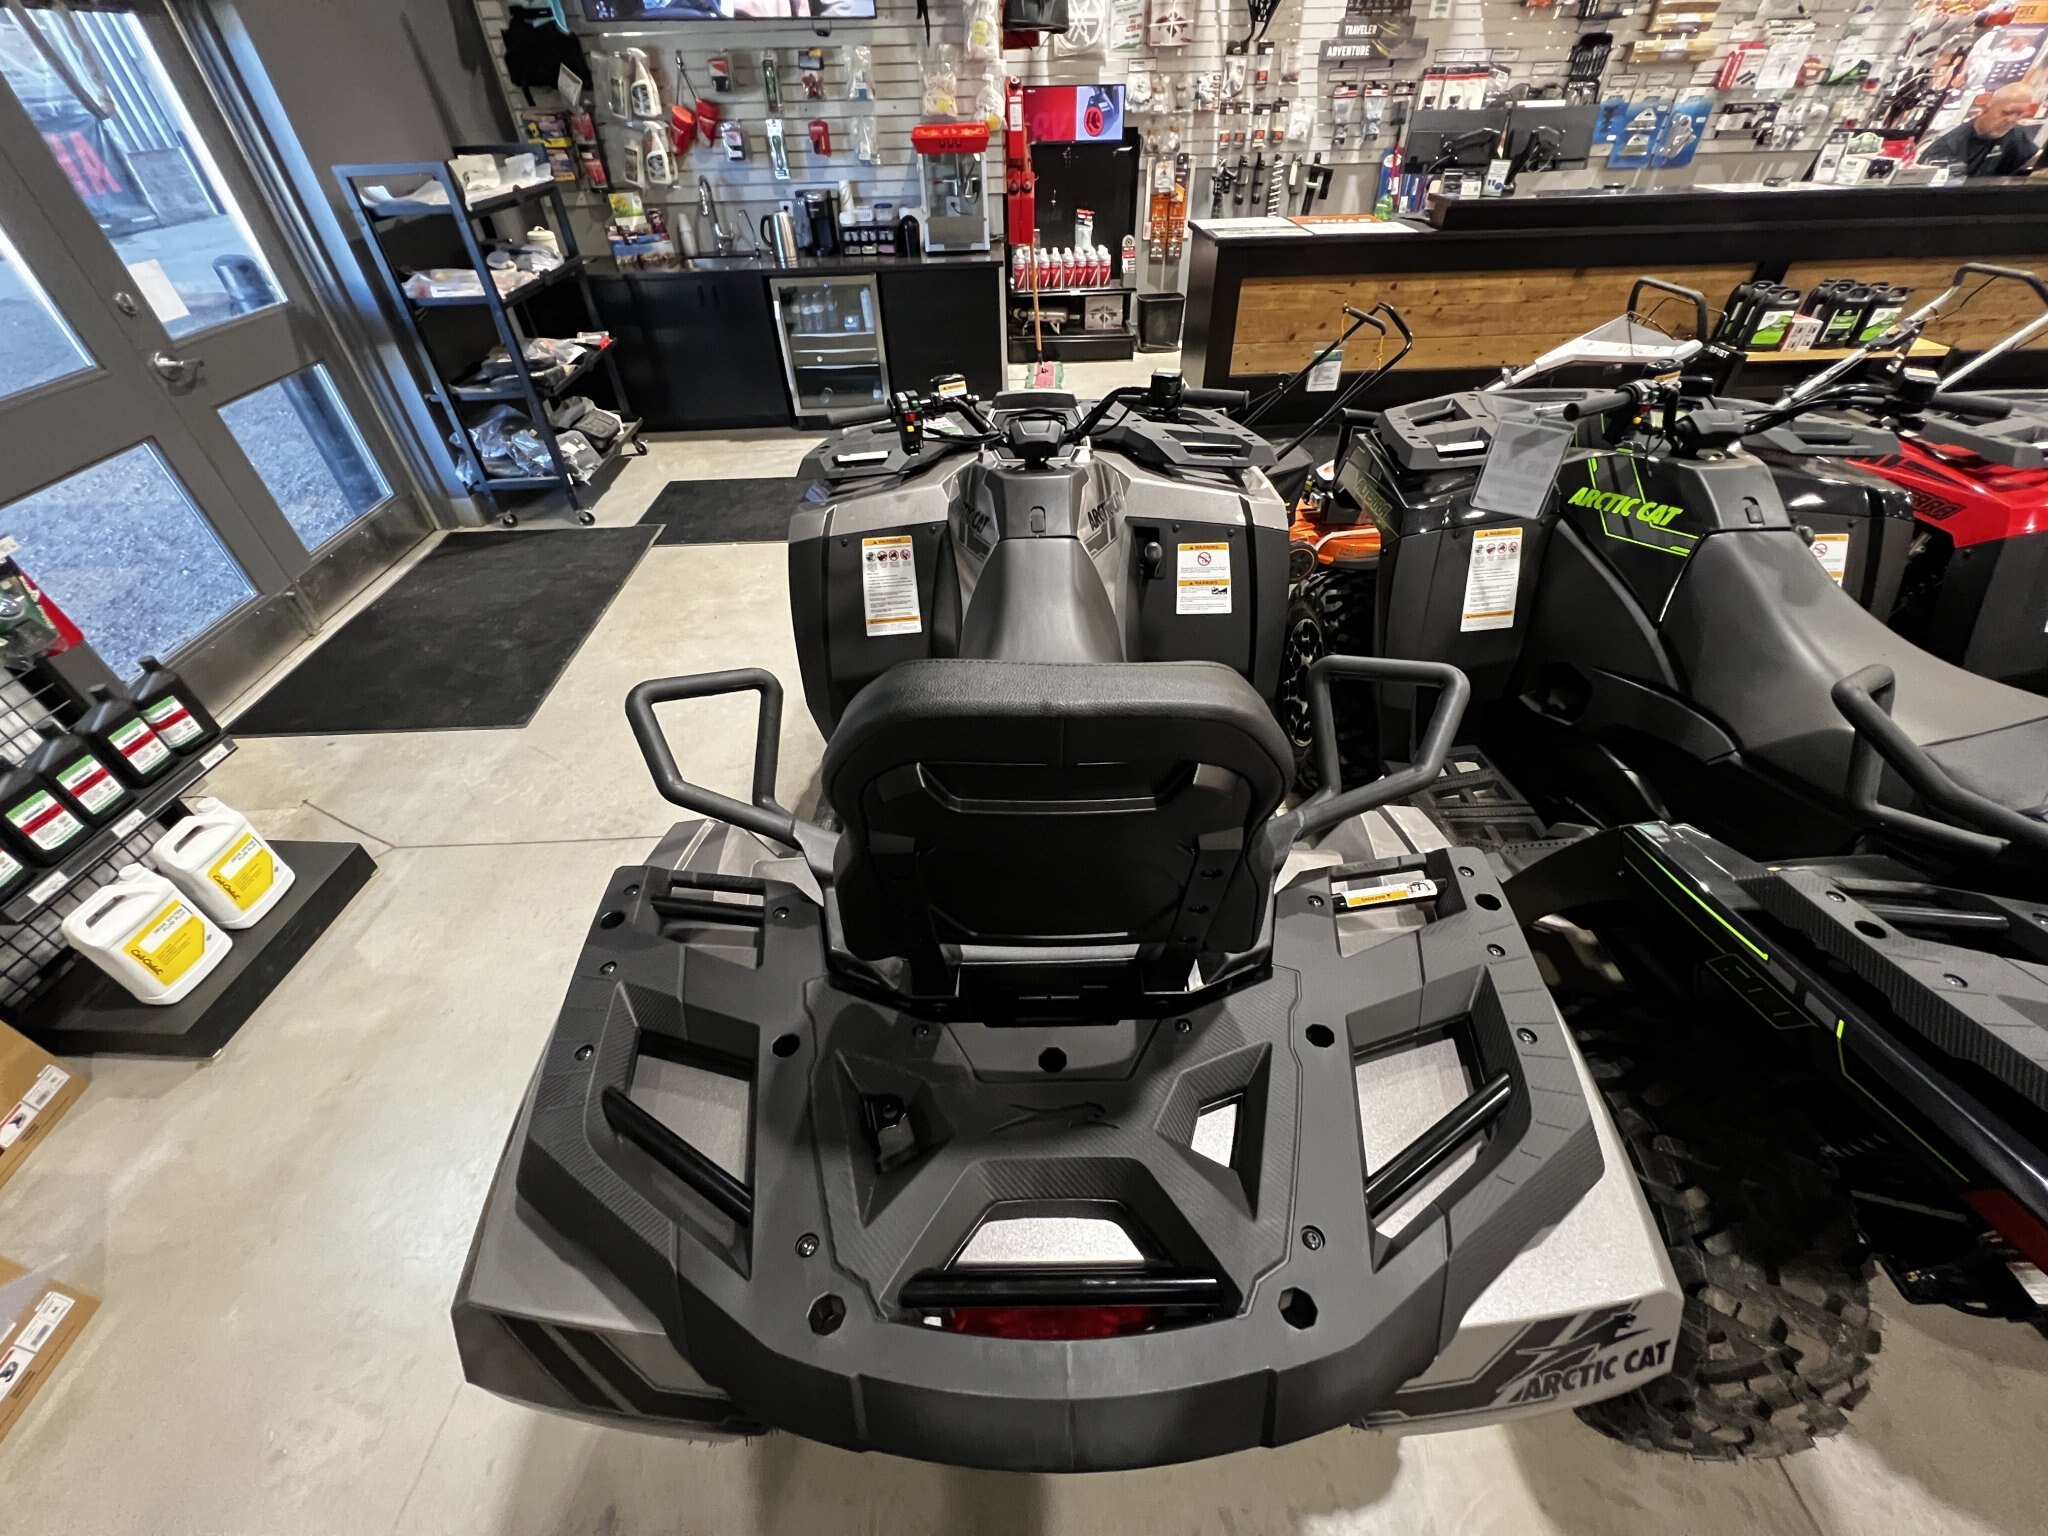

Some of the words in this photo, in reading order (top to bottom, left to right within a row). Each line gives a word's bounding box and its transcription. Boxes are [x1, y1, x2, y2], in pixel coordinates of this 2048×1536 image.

[1344, 24, 1378, 35] TRAVELER
[1326, 45, 1371, 56] ADVENTURE
[1567, 487, 1642, 517] ARCTIC
[1636, 502, 1684, 526] CAT
[971, 512, 990, 534] CAT
[1521, 1356, 1619, 1401] ARCTIC
[1624, 1339, 1672, 1374] CAT
